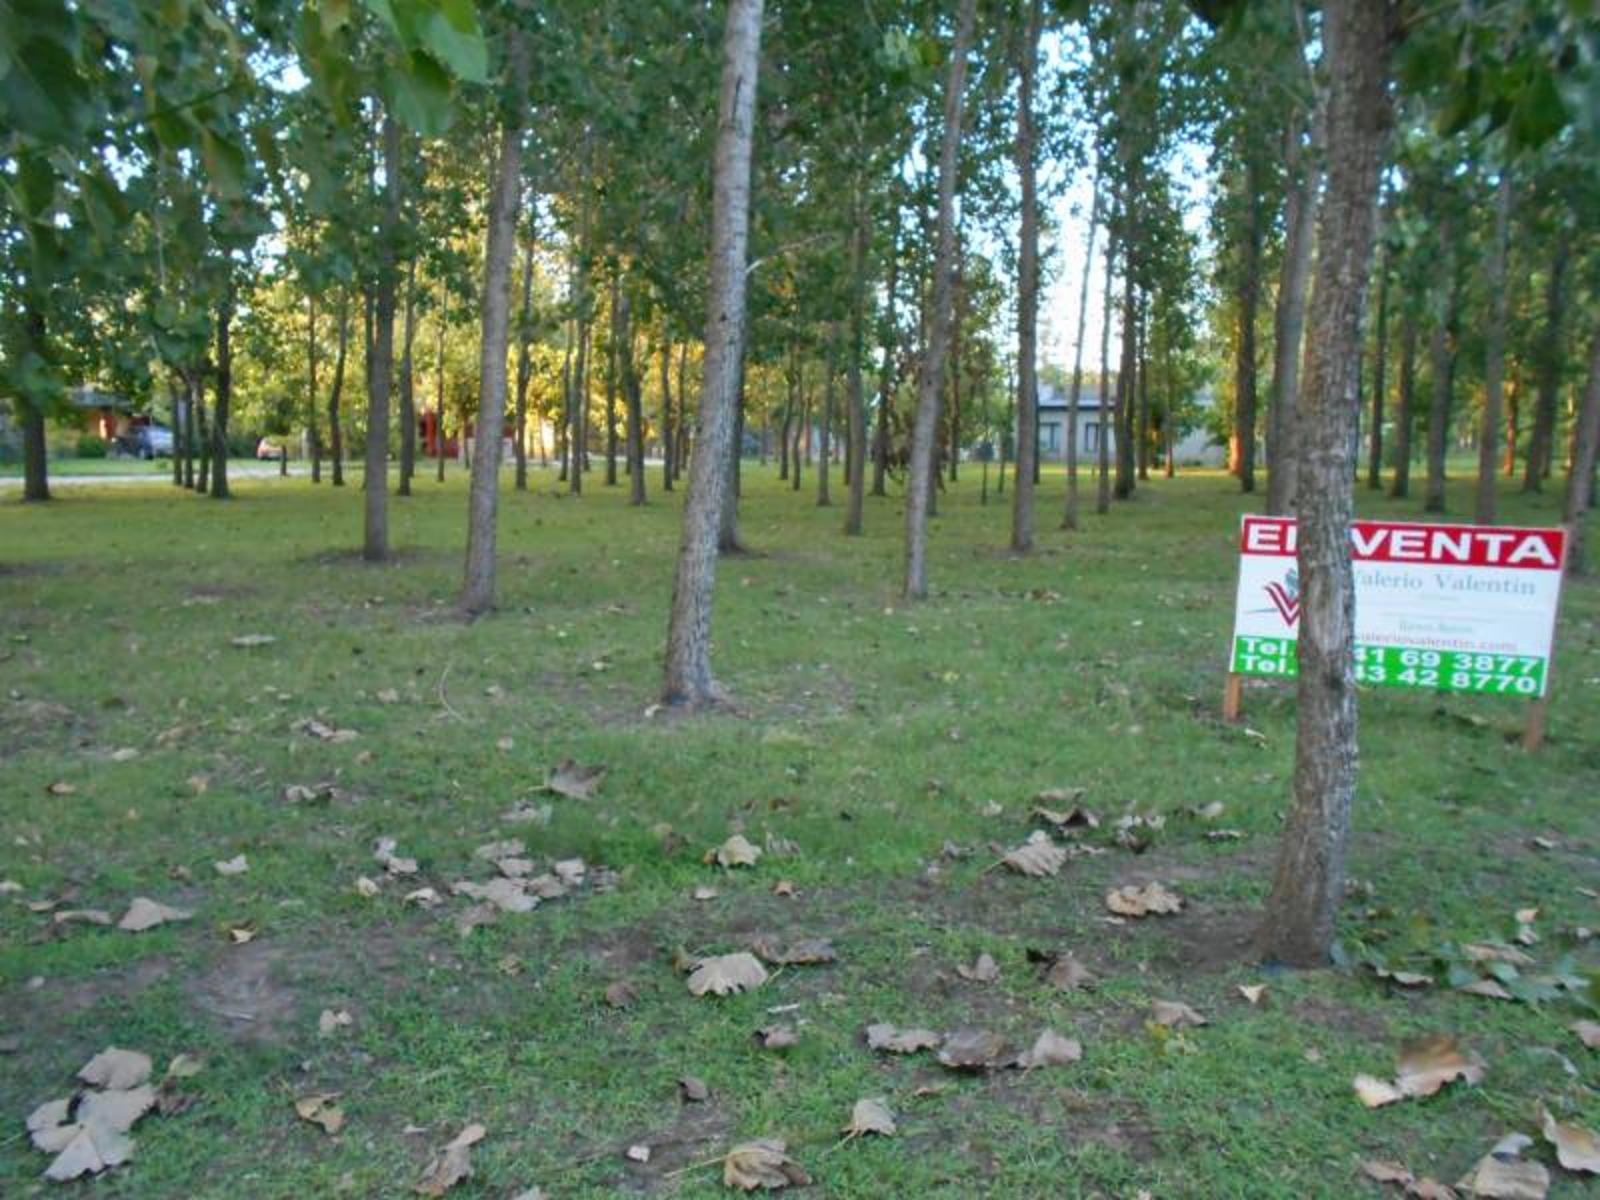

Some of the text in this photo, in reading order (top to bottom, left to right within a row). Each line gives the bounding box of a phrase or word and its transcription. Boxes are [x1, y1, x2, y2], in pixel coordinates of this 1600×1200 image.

[1248, 523, 1556, 565] E VENTA
[1355, 569, 1423, 590] alerio
[1239, 654, 1296, 676] Tel.
[1397, 668, 1439, 687] 42
[1451, 671, 1538, 693] 8770
[1400, 650, 1441, 668] 69
[1454, 653, 1540, 674] 3877
